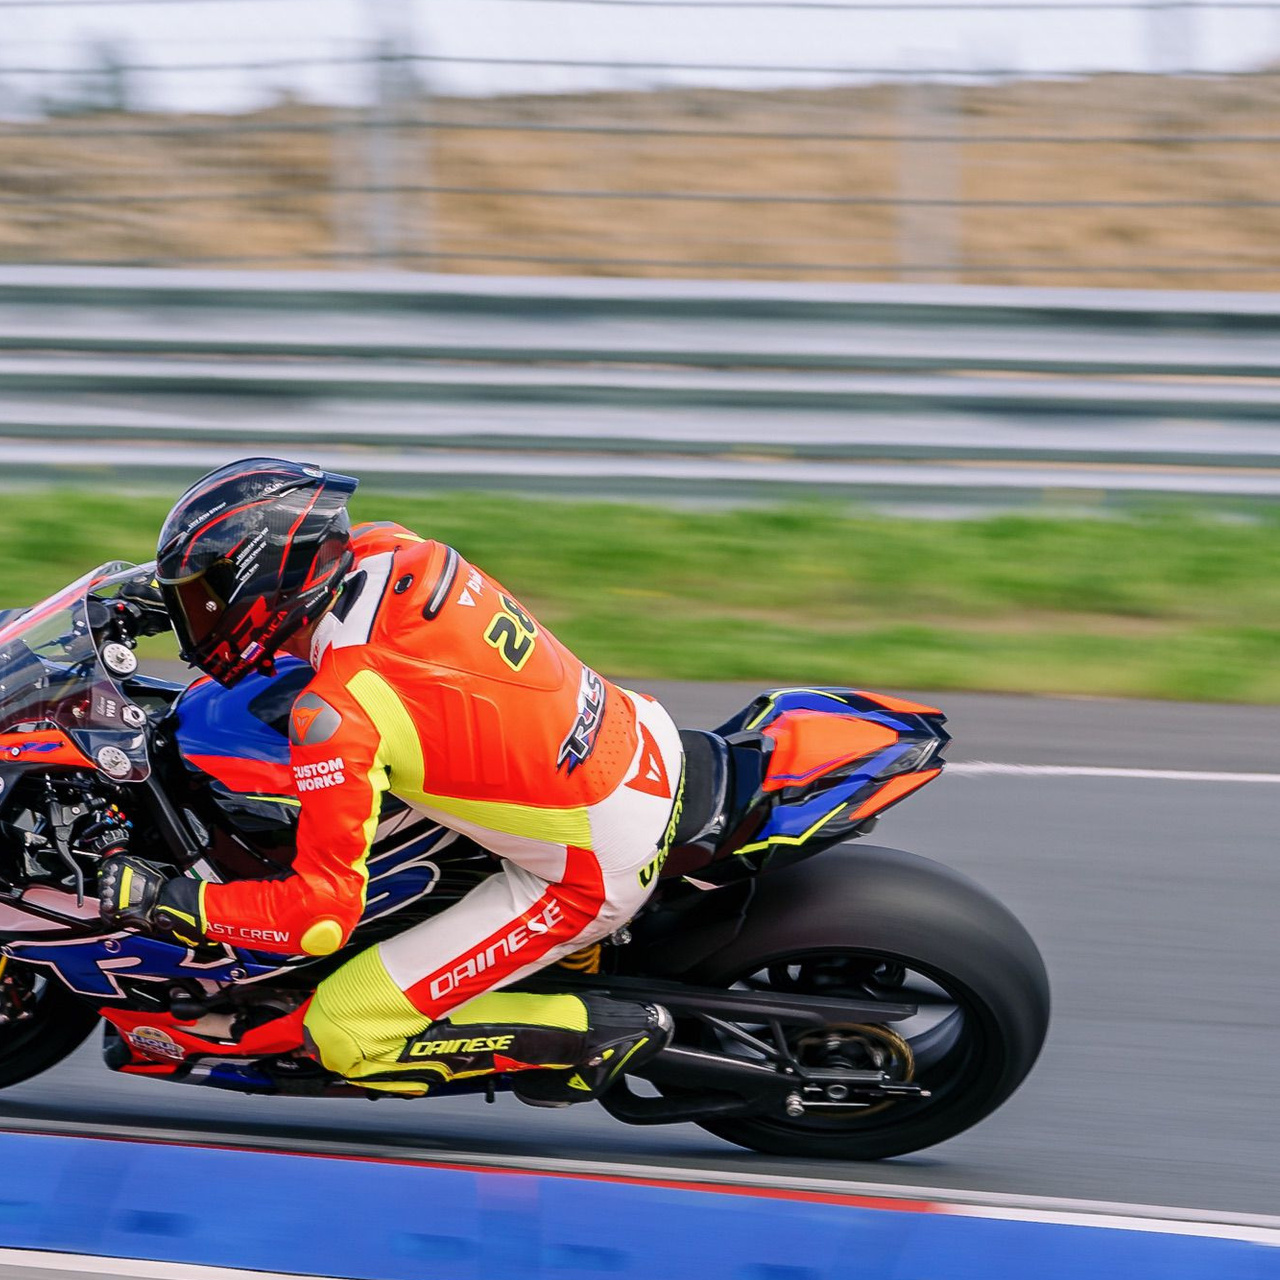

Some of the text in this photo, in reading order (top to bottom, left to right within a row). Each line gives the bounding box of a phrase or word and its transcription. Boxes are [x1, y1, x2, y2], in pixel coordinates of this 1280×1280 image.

[483, 593, 538, 672] 28
[296, 771, 345, 792] WORKS
[240, 927, 290, 942] CREW
[429, 898, 564, 1001] DAINESE
[409, 1035, 515, 1057] DAINESE
